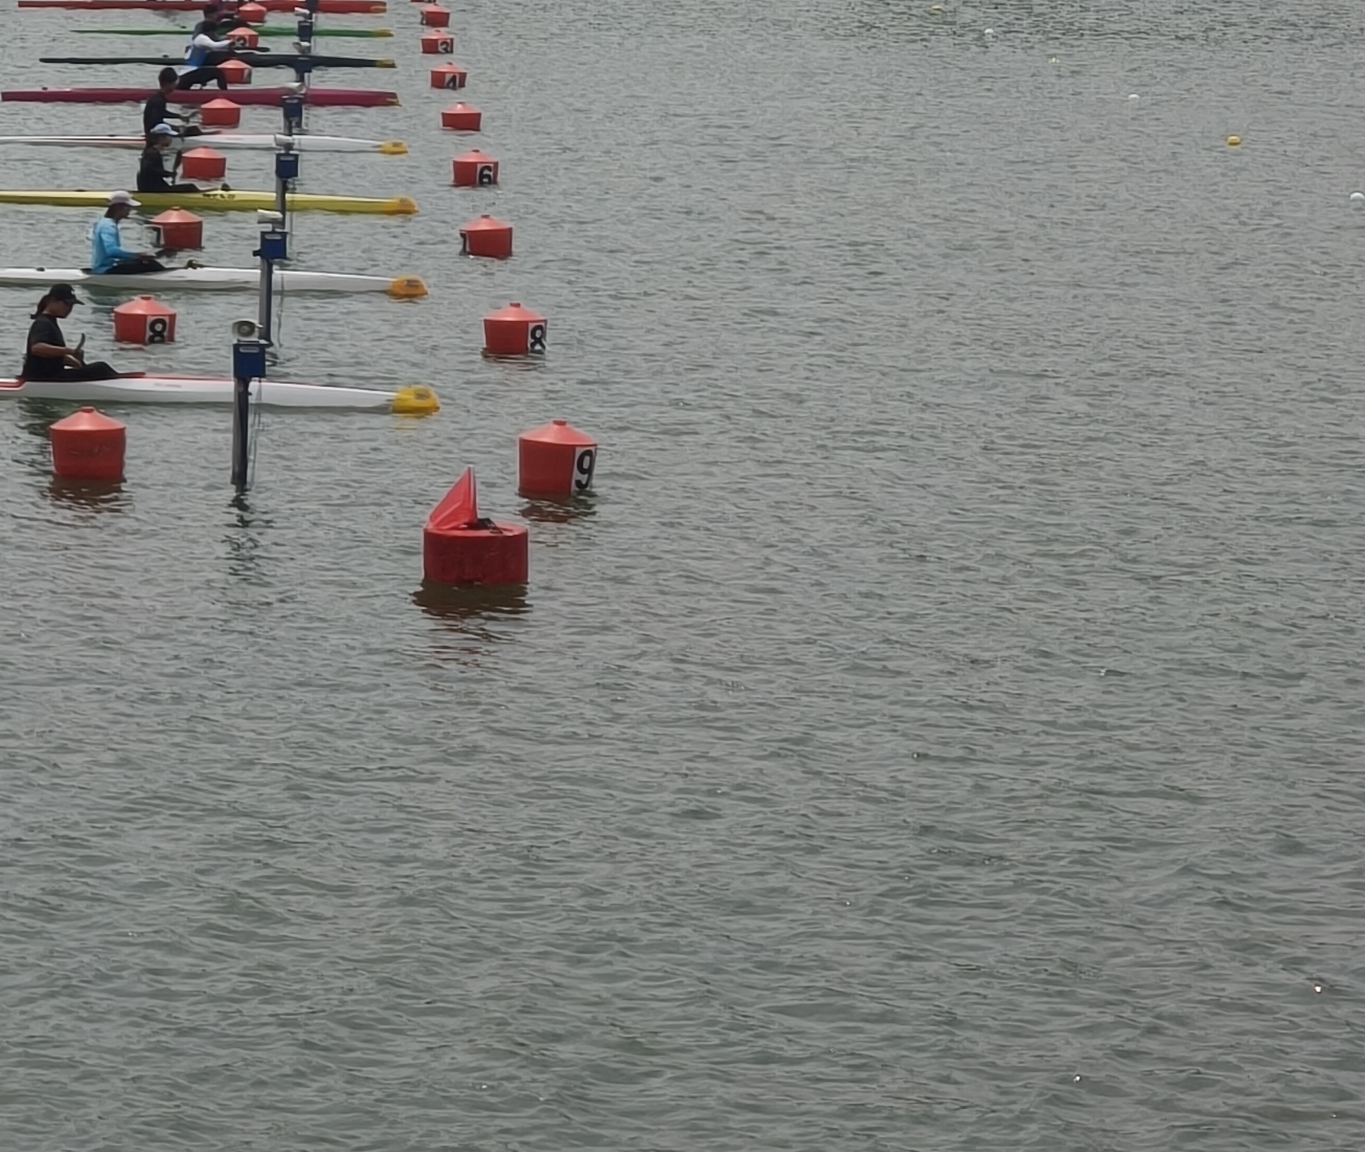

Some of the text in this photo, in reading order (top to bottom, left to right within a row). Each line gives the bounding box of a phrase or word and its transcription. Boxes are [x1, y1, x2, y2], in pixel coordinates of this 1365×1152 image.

[439, 40, 450, 54] 3
[445, 74, 458, 90] 4
[478, 164, 493, 186] 6
[148, 317, 168, 343] 8
[530, 324, 546, 351] 8
[575, 449, 594, 490] 9
